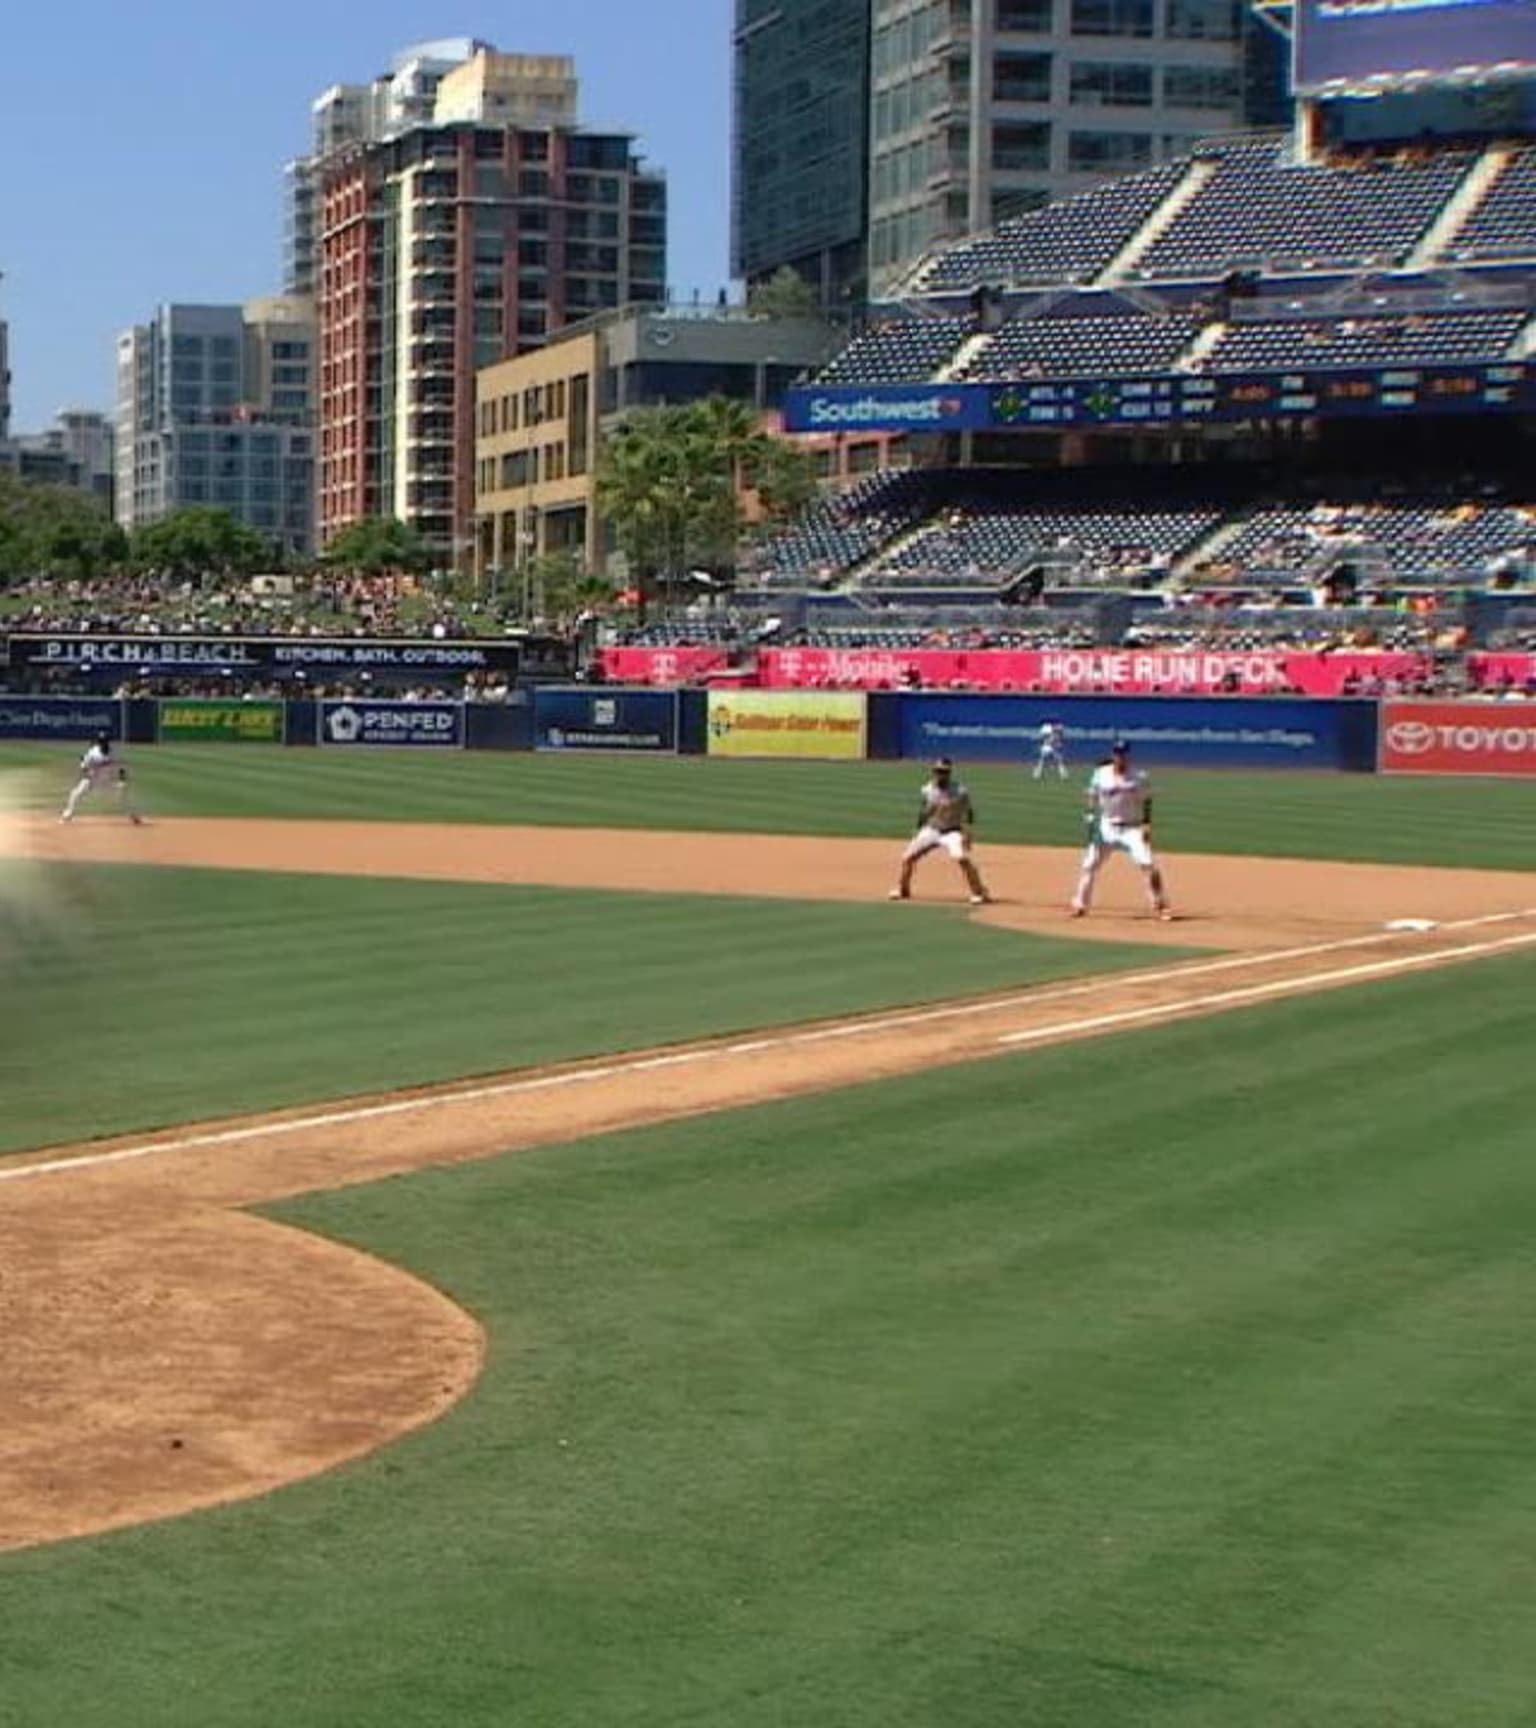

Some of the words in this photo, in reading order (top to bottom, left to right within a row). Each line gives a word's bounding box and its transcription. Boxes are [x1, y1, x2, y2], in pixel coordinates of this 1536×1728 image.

[810, 397, 940, 422] Southwest
[47, 642, 141, 662] PIRCH
[160, 642, 247, 662] BEACH
[1041, 655, 1131, 684] HOME
[1133, 655, 1198, 684] RUN
[364, 711, 453, 730] PENFED
